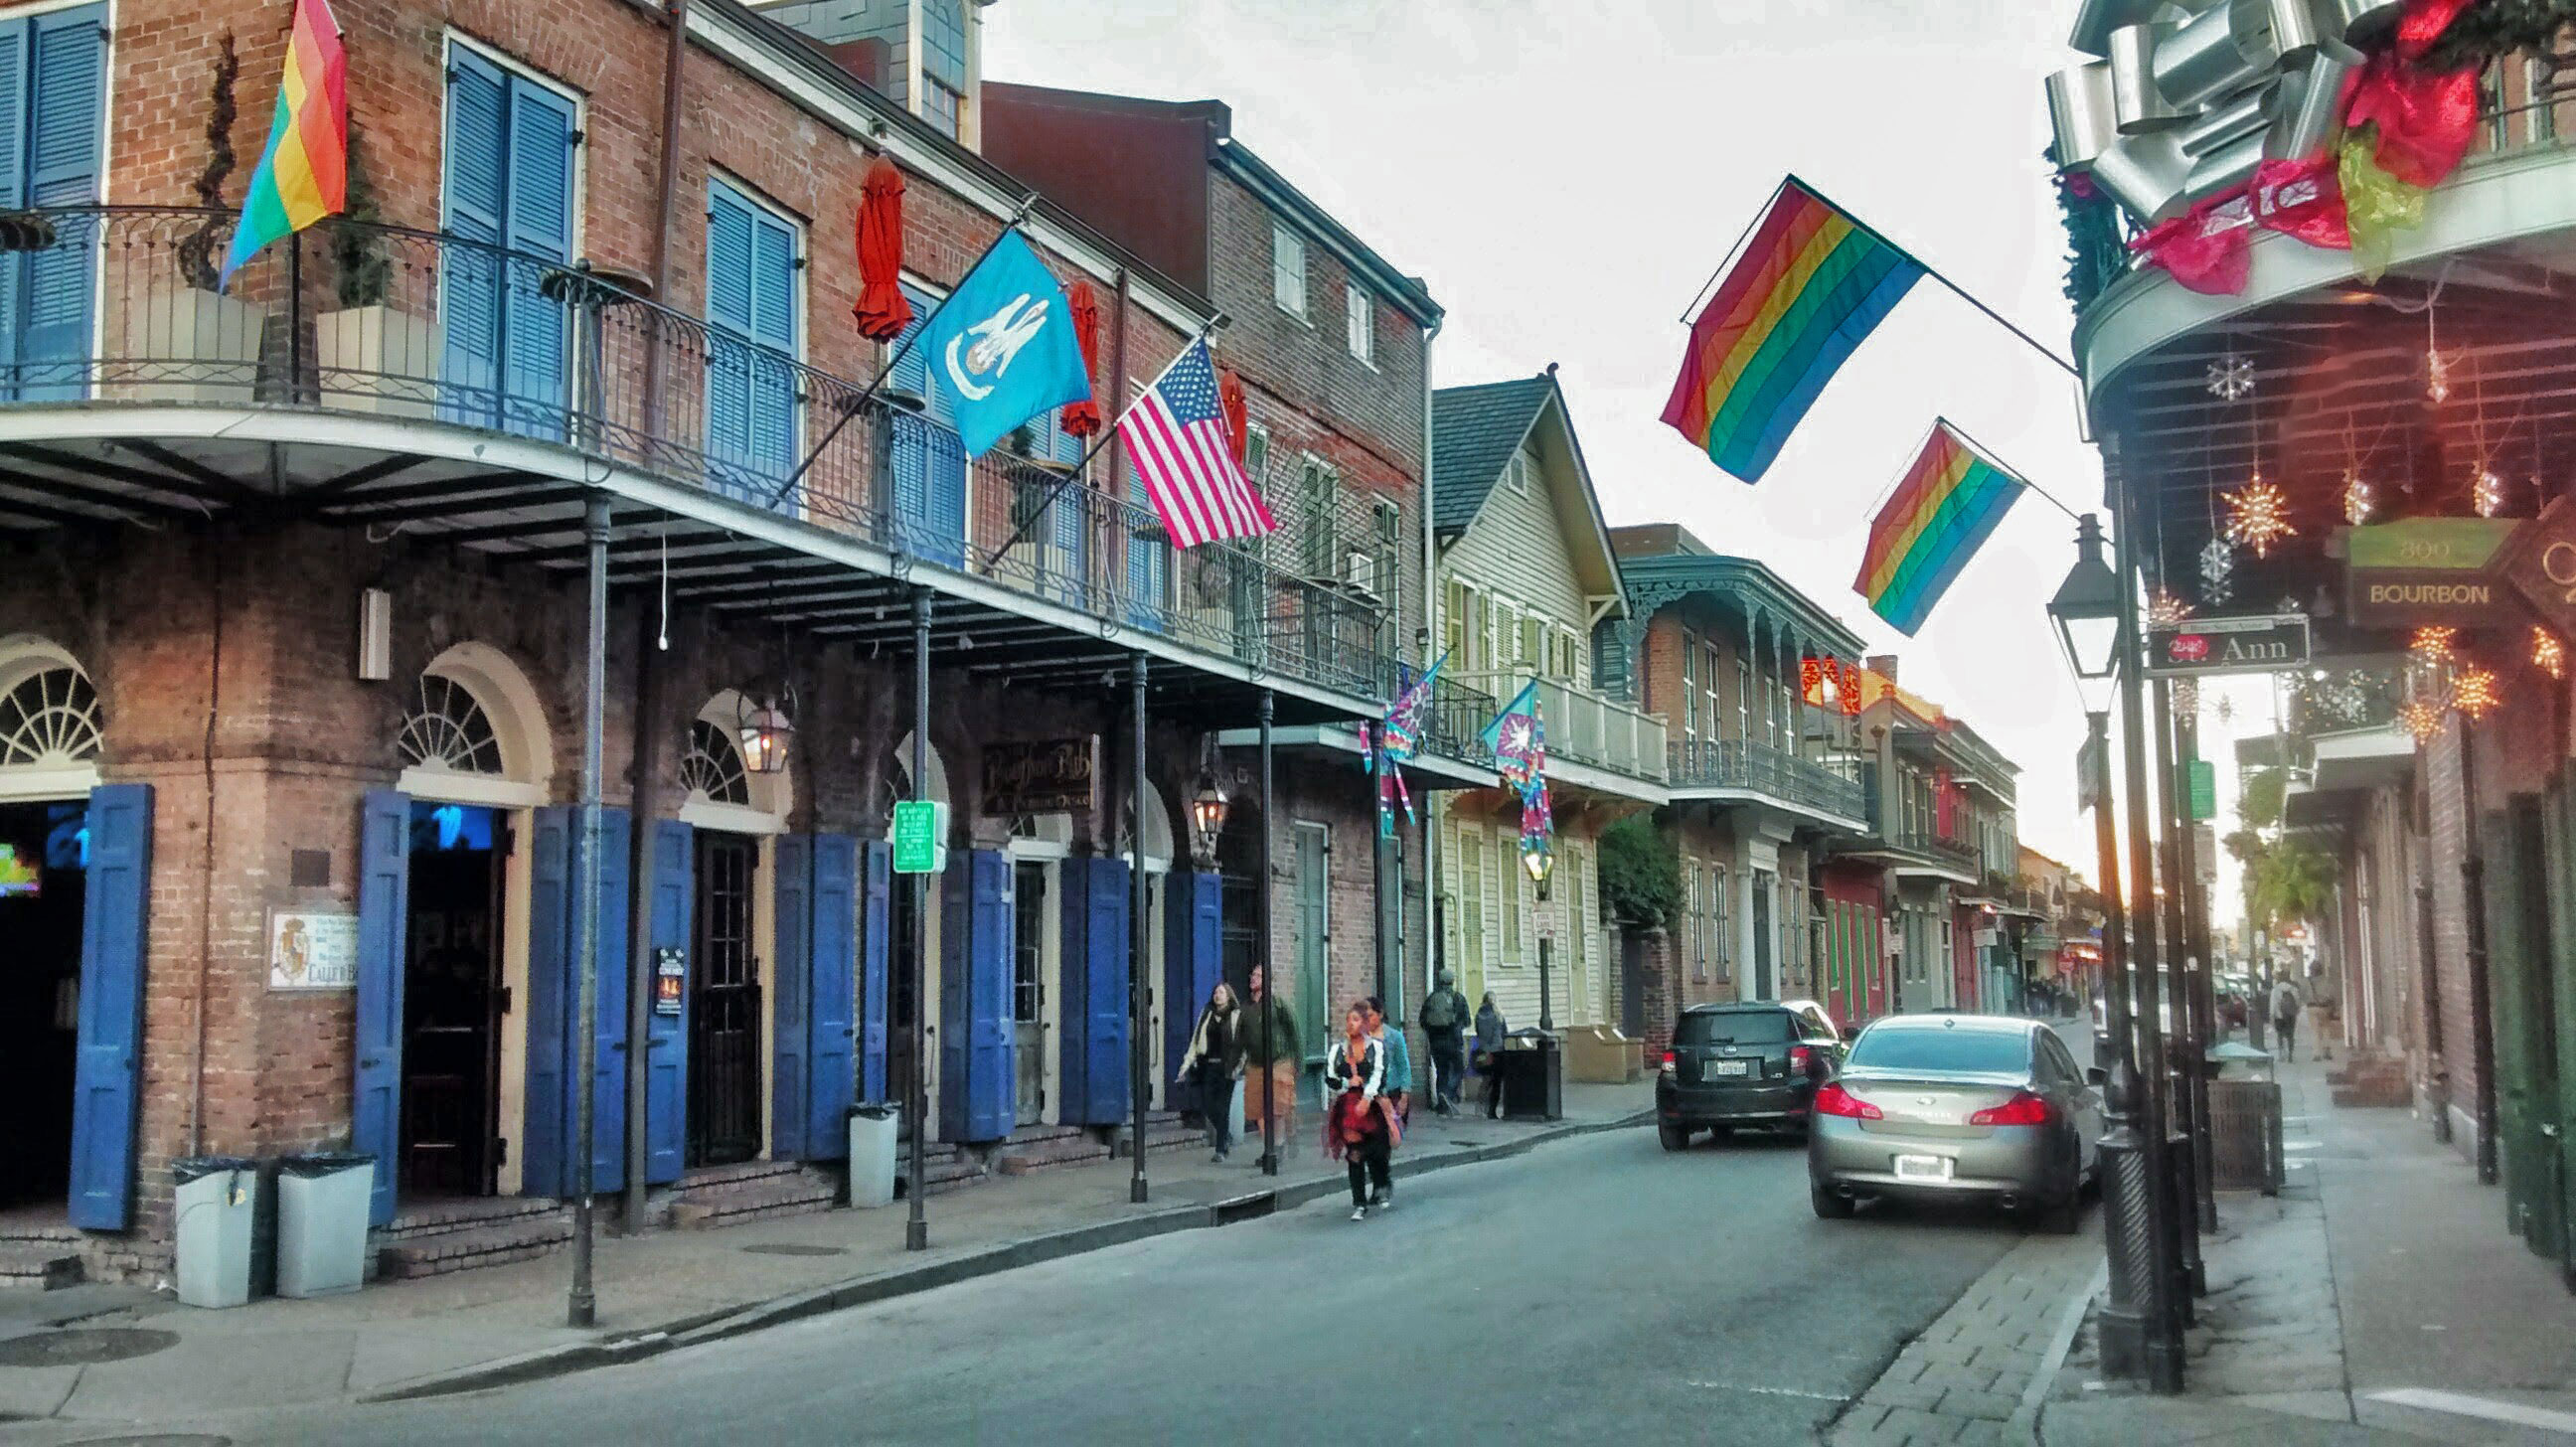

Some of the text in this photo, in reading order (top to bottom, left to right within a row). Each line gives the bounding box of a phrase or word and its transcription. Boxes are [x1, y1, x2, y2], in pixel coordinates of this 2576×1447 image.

[2400, 540, 2451, 560] 800
[2369, 584, 2491, 604] BOURBON
[2221, 637, 2288, 661] Ann
